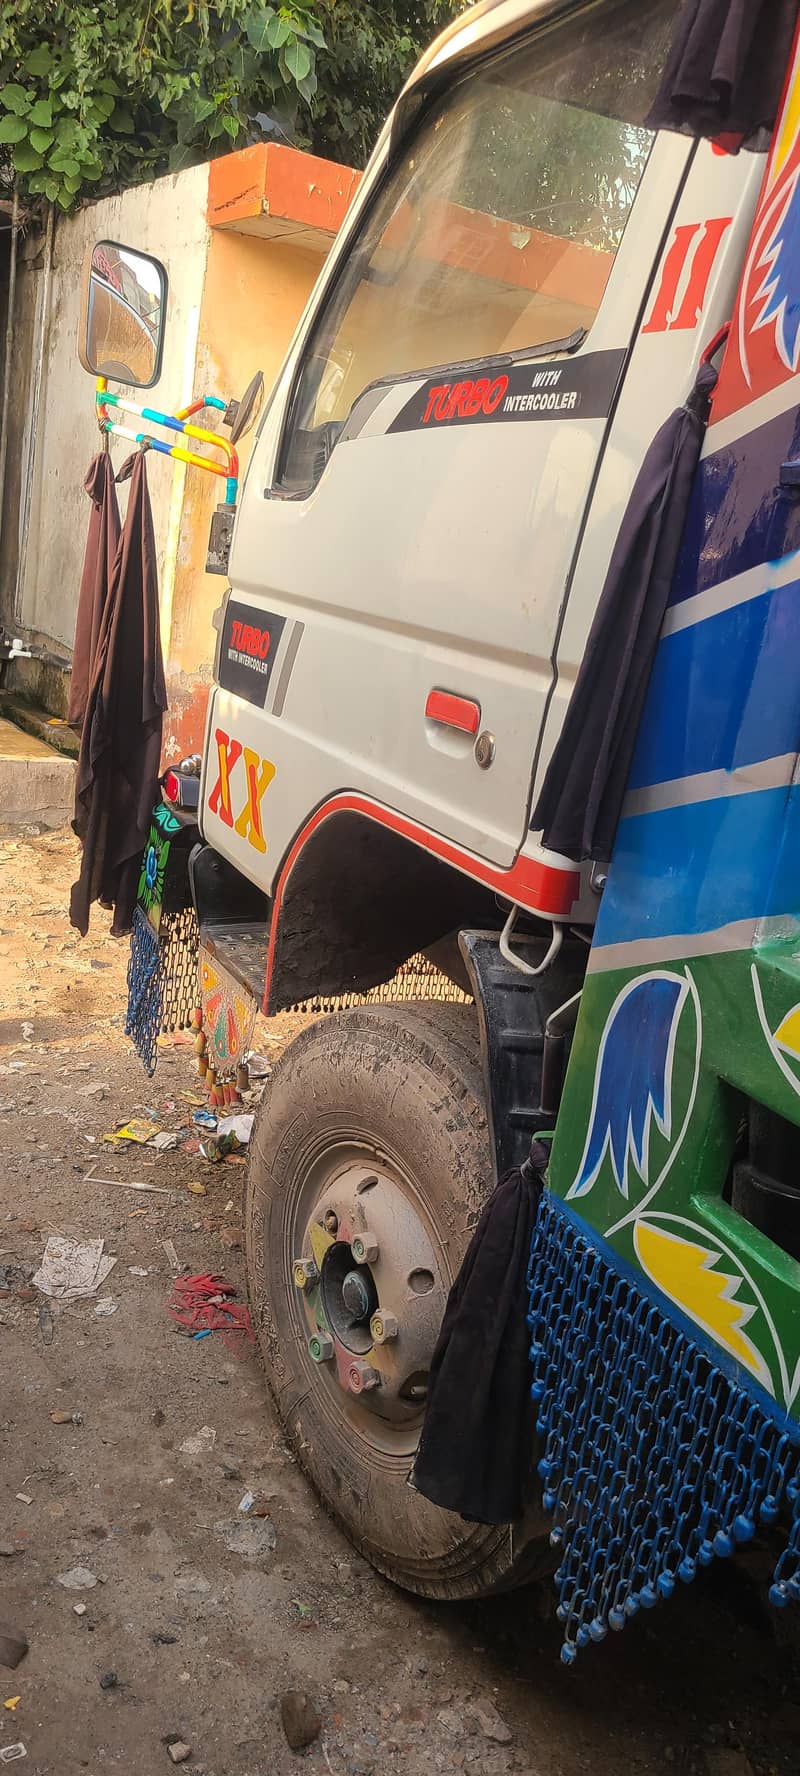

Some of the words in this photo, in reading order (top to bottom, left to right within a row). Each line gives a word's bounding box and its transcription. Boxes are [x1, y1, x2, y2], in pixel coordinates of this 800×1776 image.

[531, 369, 562, 388] WITH
[422, 374, 509, 423] TURBO
[503, 391, 577, 413] INTERCOOLER
[230, 620, 270, 659] TURBO
[228, 648, 239, 664] WITH
[239, 652, 268, 675] INTERCOOLER
[208, 728, 276, 855] XX
